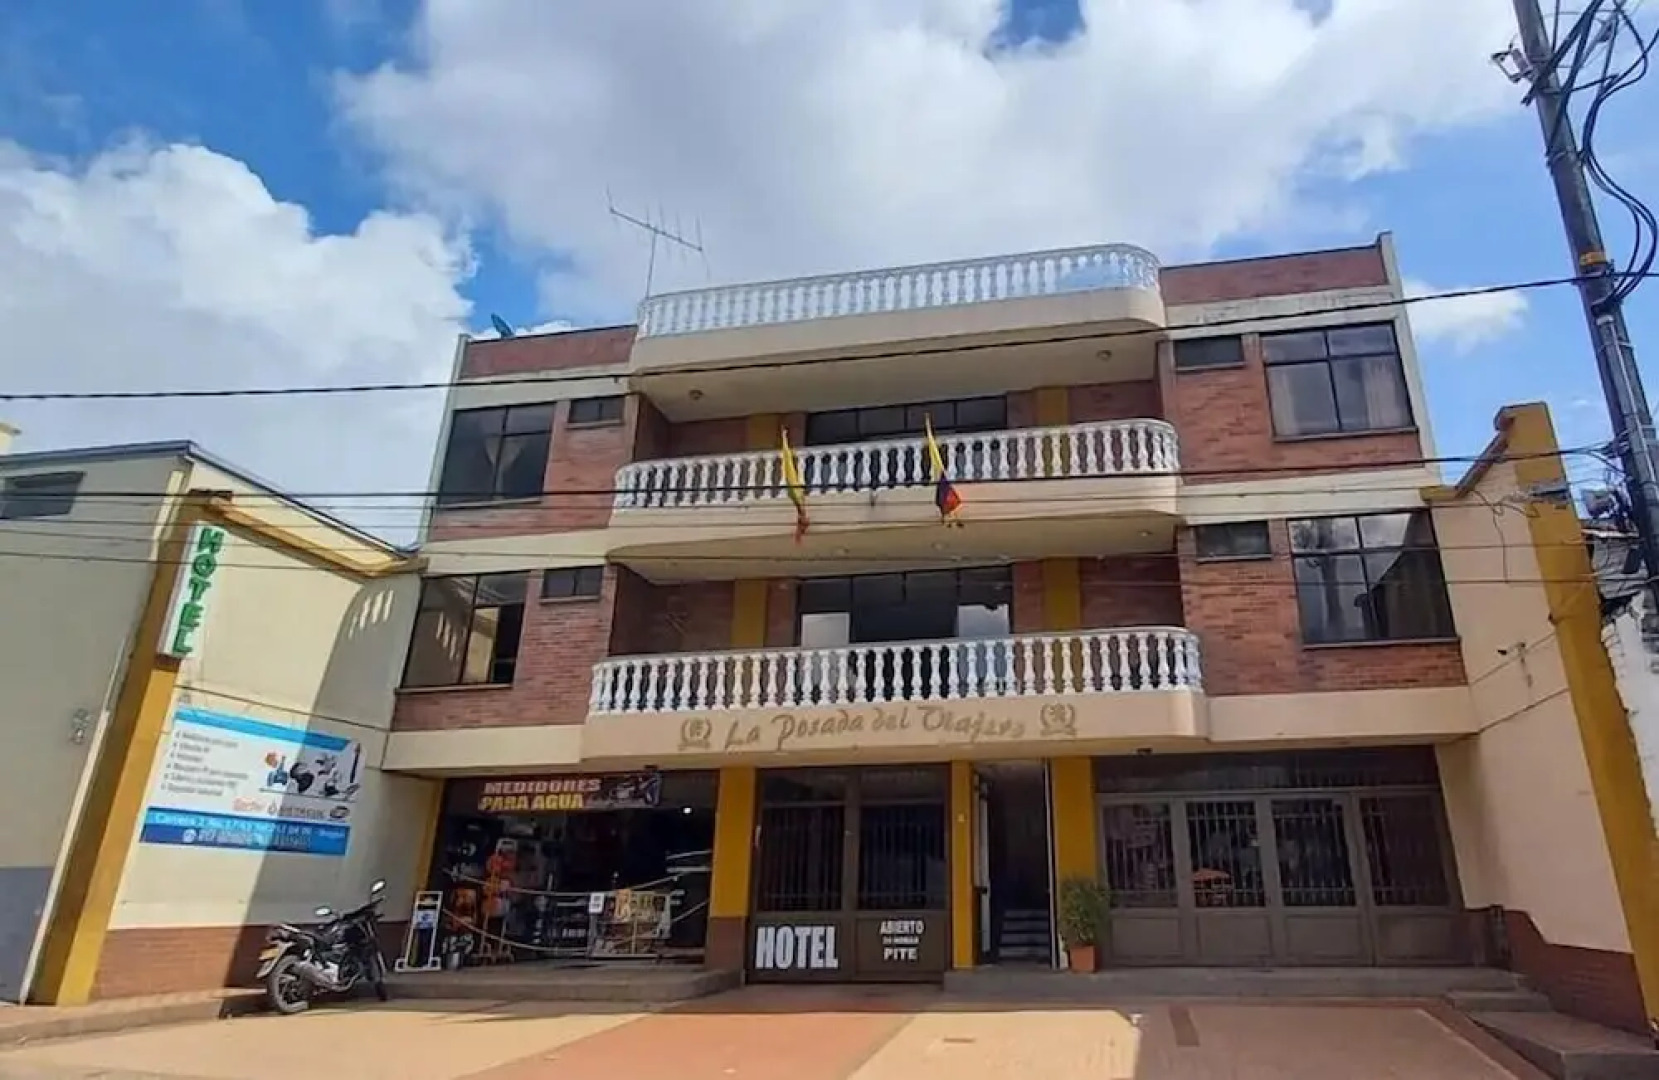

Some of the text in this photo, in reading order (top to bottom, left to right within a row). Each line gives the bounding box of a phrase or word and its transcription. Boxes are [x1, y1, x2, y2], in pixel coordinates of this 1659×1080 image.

[172, 527, 225, 654] HOTEL
[724, 718, 761, 751] La
[770, 708, 864, 752] Posada
[871, 705, 911, 732] del
[483, 778, 602, 795] MEDIDORES
[477, 792, 585, 811] PARA AGUA
[879, 919, 925, 935] ABIERTO
[754, 925, 839, 970] HOTEL
[883, 947, 918, 961] PITE
